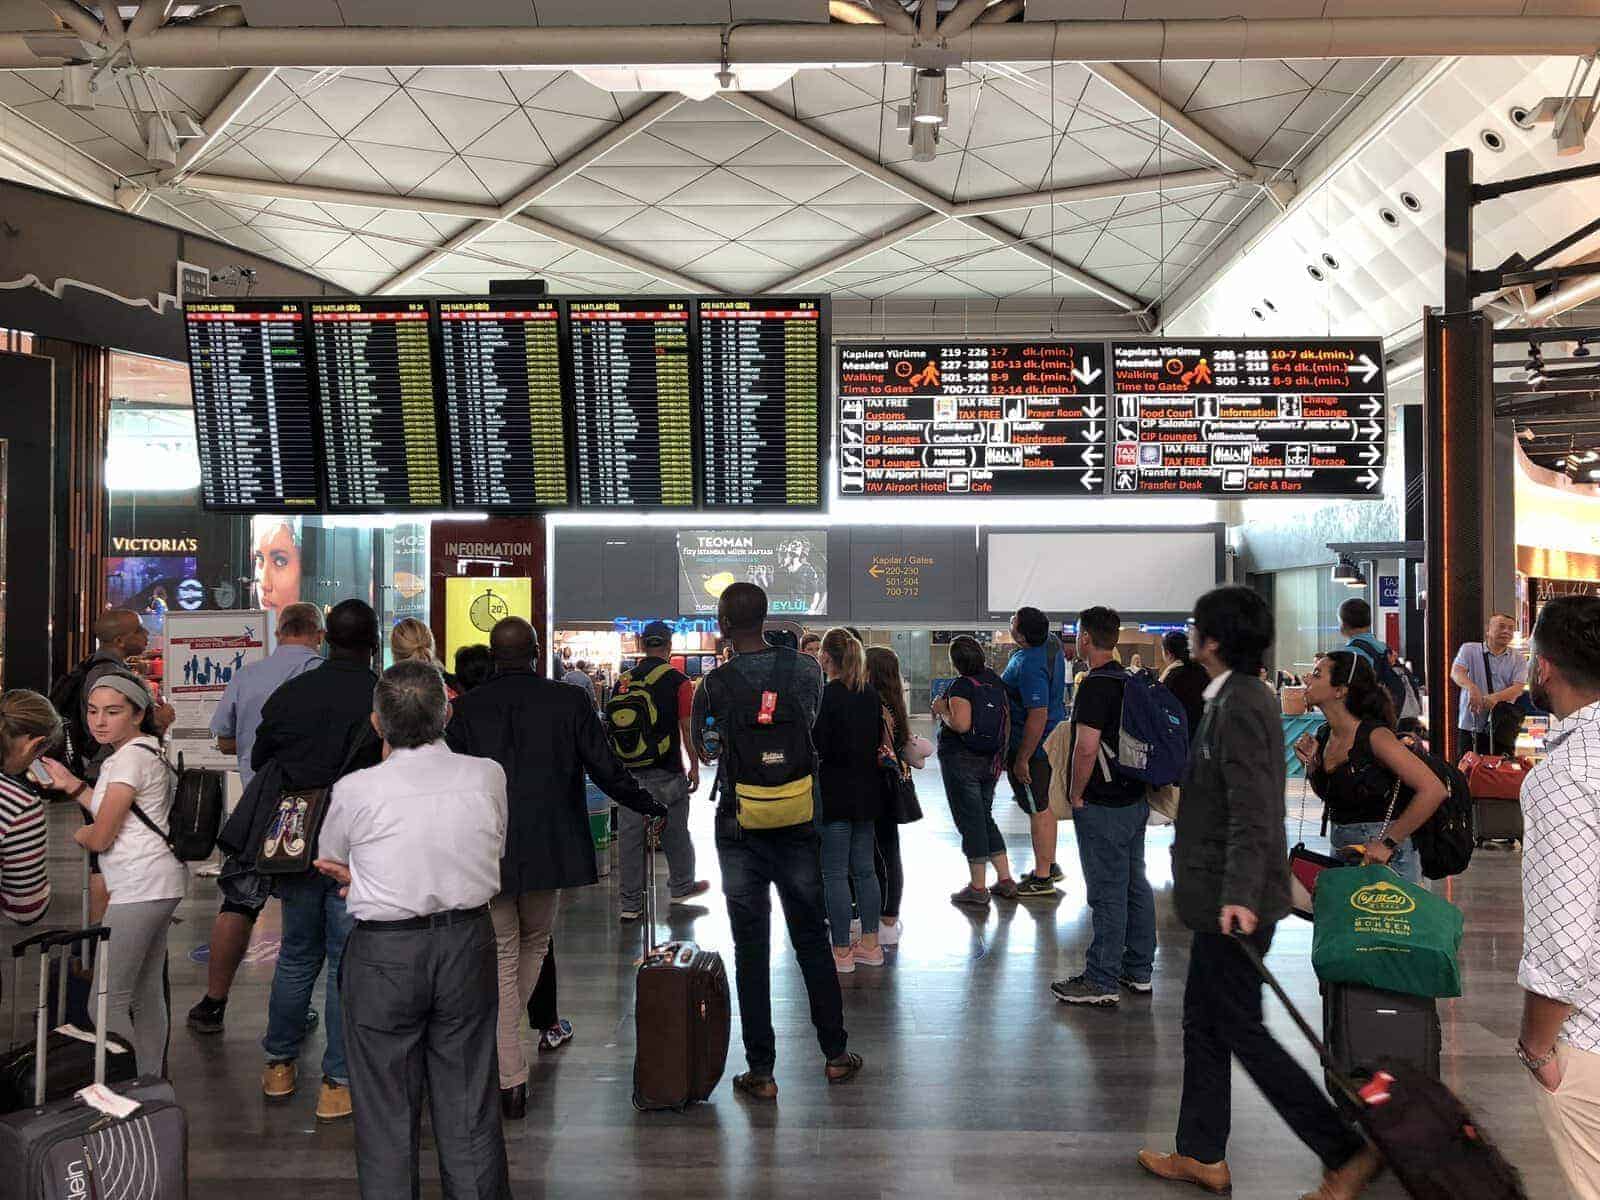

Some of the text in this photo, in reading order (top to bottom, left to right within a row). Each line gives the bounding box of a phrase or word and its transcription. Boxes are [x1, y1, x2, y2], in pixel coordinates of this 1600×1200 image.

[843, 350, 927, 360] Kapılara Yürüme
[992, 348, 1008, 356] 1-7
[1271, 350, 1297, 359] 10-7
[991, 360, 1021, 369] 10-13
[1271, 363, 1291, 372] 6-4
[843, 373, 884, 384] Walking
[1115, 370, 1159, 380] Walking
[1215, 376, 1238, 386] 300
[1247, 376, 1271, 386] 312
[843, 384, 914, 393] Time to Gates
[943, 385, 988, 394] 700-712
[991, 385, 1022, 394] 12-14
[1115, 382, 1187, 391] Time to Gates
[865, 399, 885, 407] TAX
[959, 398, 976, 406] TAX
[865, 412, 906, 420] Customs
[959, 410, 1001, 418] TAX FREE
[1028, 409, 1055, 419] Prayer
[1140, 409, 1193, 418] Food Court
[1220, 408, 1277, 417] Information
[1303, 407, 1348, 418] Exchange
[865, 435, 921, 444] CIP Lounges
[1012, 434, 1066, 443] Hairdresser
[1140, 432, 1198, 442] CIP Lounges
[1164, 445, 1183, 453] TAX
[1252, 444, 1270, 453] WC
[865, 459, 921, 468] CIP Lounges
[1023, 458, 1054, 467] Toilets
[1164, 457, 1208, 466] TAX FREE
[1252, 457, 1282, 465] Toilets
[1311, 457, 1346, 465] Terrace
[865, 482, 946, 492] TAV Airport Hotel
[971, 483, 992, 491] Cafe
[1140, 481, 1203, 490] Transfer Desk
[1247, 482, 1269, 490] Cafe
[1281, 481, 1302, 490] Bars
[112, 537, 198, 551] VICTORIA'S
[697, 536, 753, 548] TEOMAN
[445, 542, 532, 556] INFORMATION
[885, 567, 919, 575] 220-230
[773, 598, 808, 610] EYLÜL
[64, 1160, 87, 1200] lein
